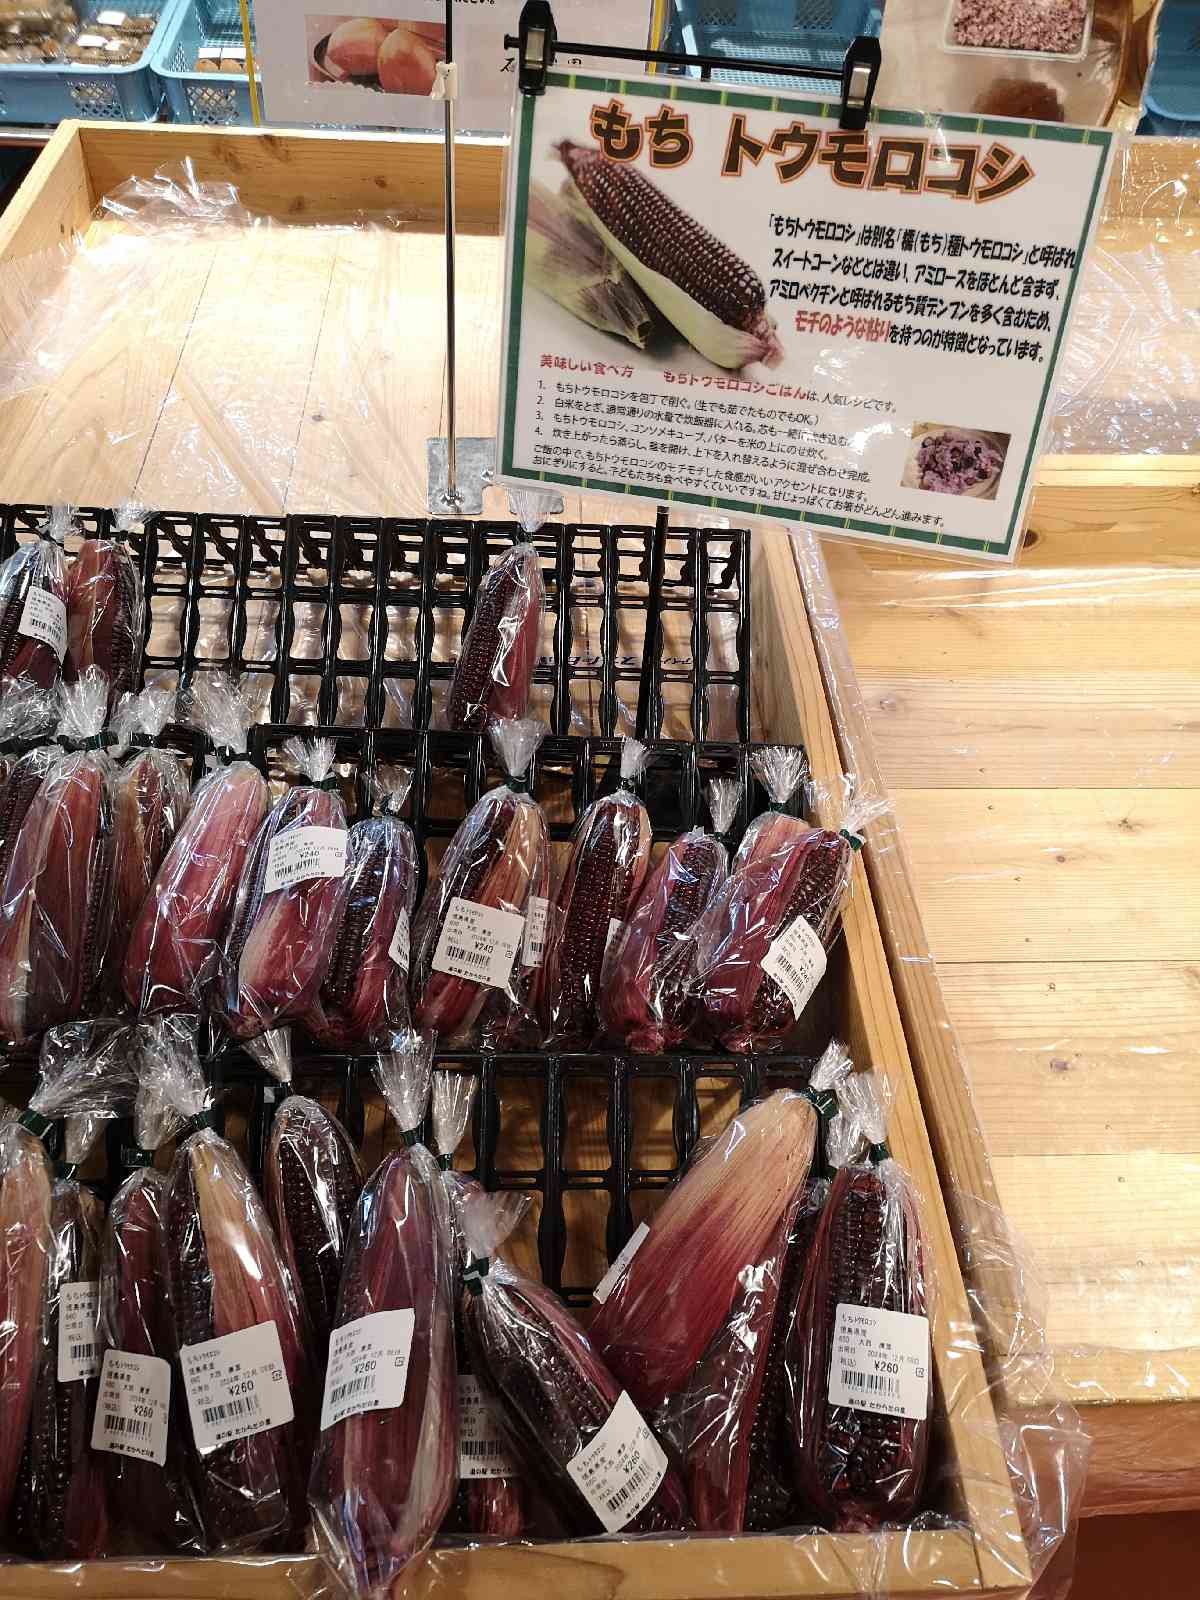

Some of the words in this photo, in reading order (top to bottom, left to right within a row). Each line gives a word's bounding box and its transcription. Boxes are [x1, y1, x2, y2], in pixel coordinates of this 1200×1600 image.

[590, 99, 693, 169] もち
[720, 113, 1036, 204] トウモロコシ
[540, 354, 635, 379] 美味しい食べ方
[474, 941, 494, 954] ¥240
[354, 1360, 377, 1374] ¥260
[874, 1361, 898, 1374] ¥260
[229, 1381, 254, 1397] ¥260
[134, 1406, 154, 1418] ¥260
[622, 1452, 642, 1474] ¥260
